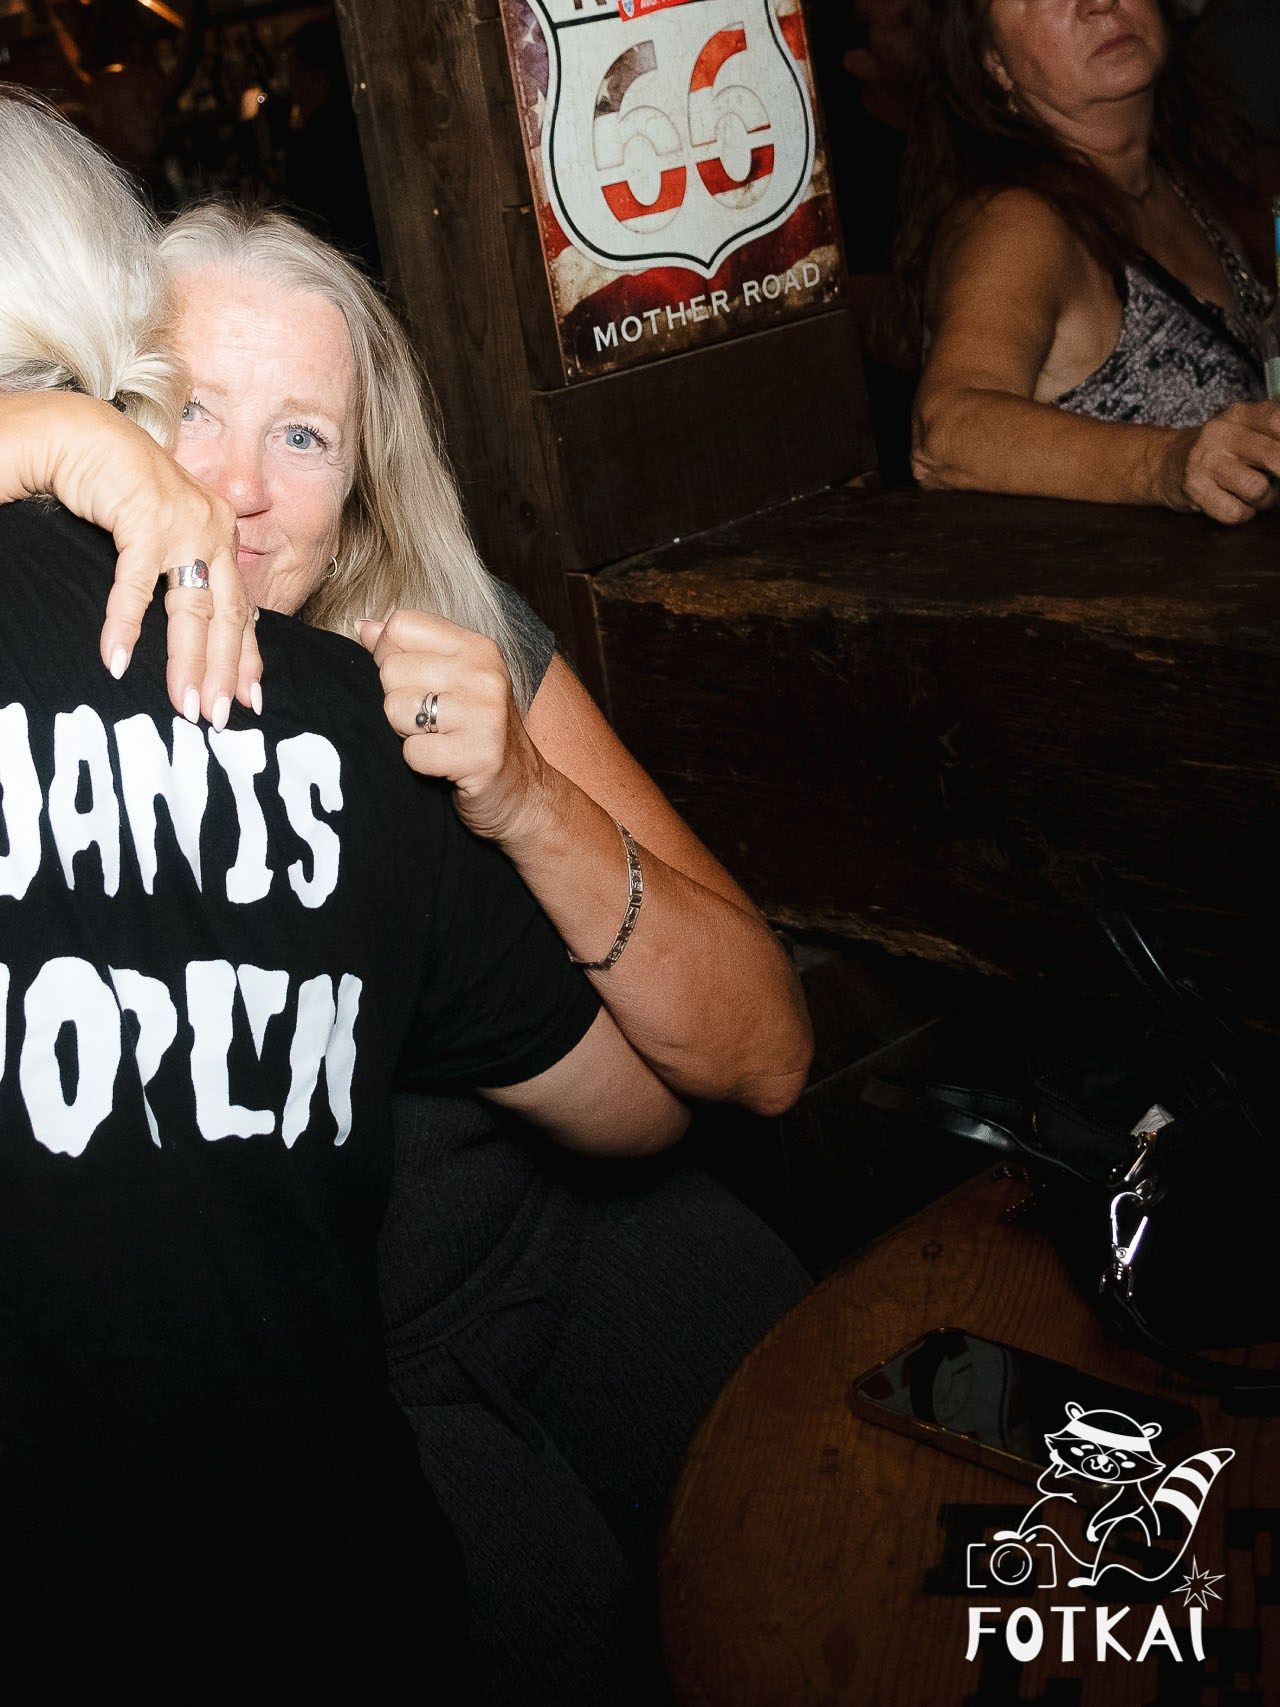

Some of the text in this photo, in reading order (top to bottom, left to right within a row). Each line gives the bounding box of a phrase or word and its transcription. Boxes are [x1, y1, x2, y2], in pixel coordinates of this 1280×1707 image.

[592, 21, 775, 234] 66
[592, 262, 821, 352] MOTHER ROAD
